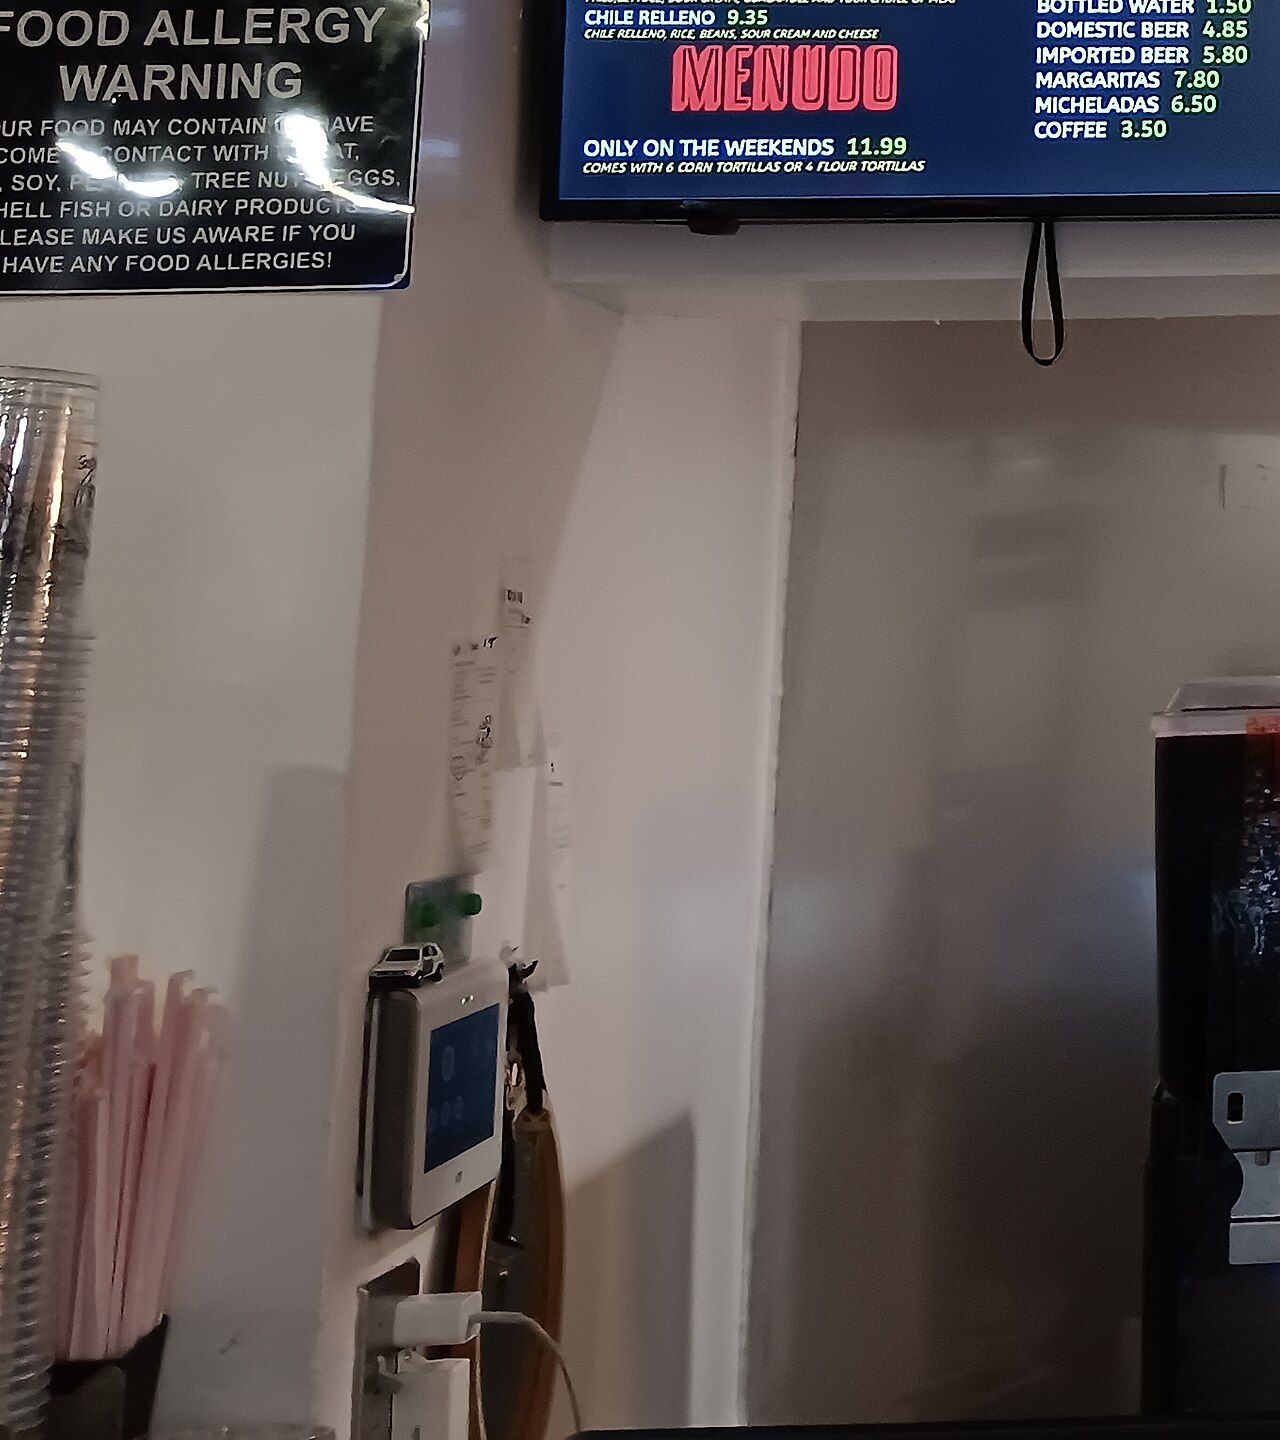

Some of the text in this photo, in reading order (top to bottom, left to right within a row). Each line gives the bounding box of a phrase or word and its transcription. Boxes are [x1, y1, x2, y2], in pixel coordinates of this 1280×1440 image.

[144, 7, 386, 45] ALLERGY
[59, 62, 302, 101] WARNING
[672, 45, 897, 111] MENUDO
[1036, 71, 1219, 89] MARGARITAS 7.80
[41, 119, 104, 140] FOOD
[114, 119, 160, 136] MAY
[167, 117, 267, 136] CONTAIN
[584, 137, 906, 156] ONLY ON THE WEEKENDS 11.99
[583, 161, 925, 173] COMES WITH 6 CORN TORTILLAS OR 4 FLOUR TORTILLAS
[82, 224, 355, 245] MAKE US AWARE IF YOU
[3, 252, 331, 273] HAVE ANY FOOD ALLERGIES!
